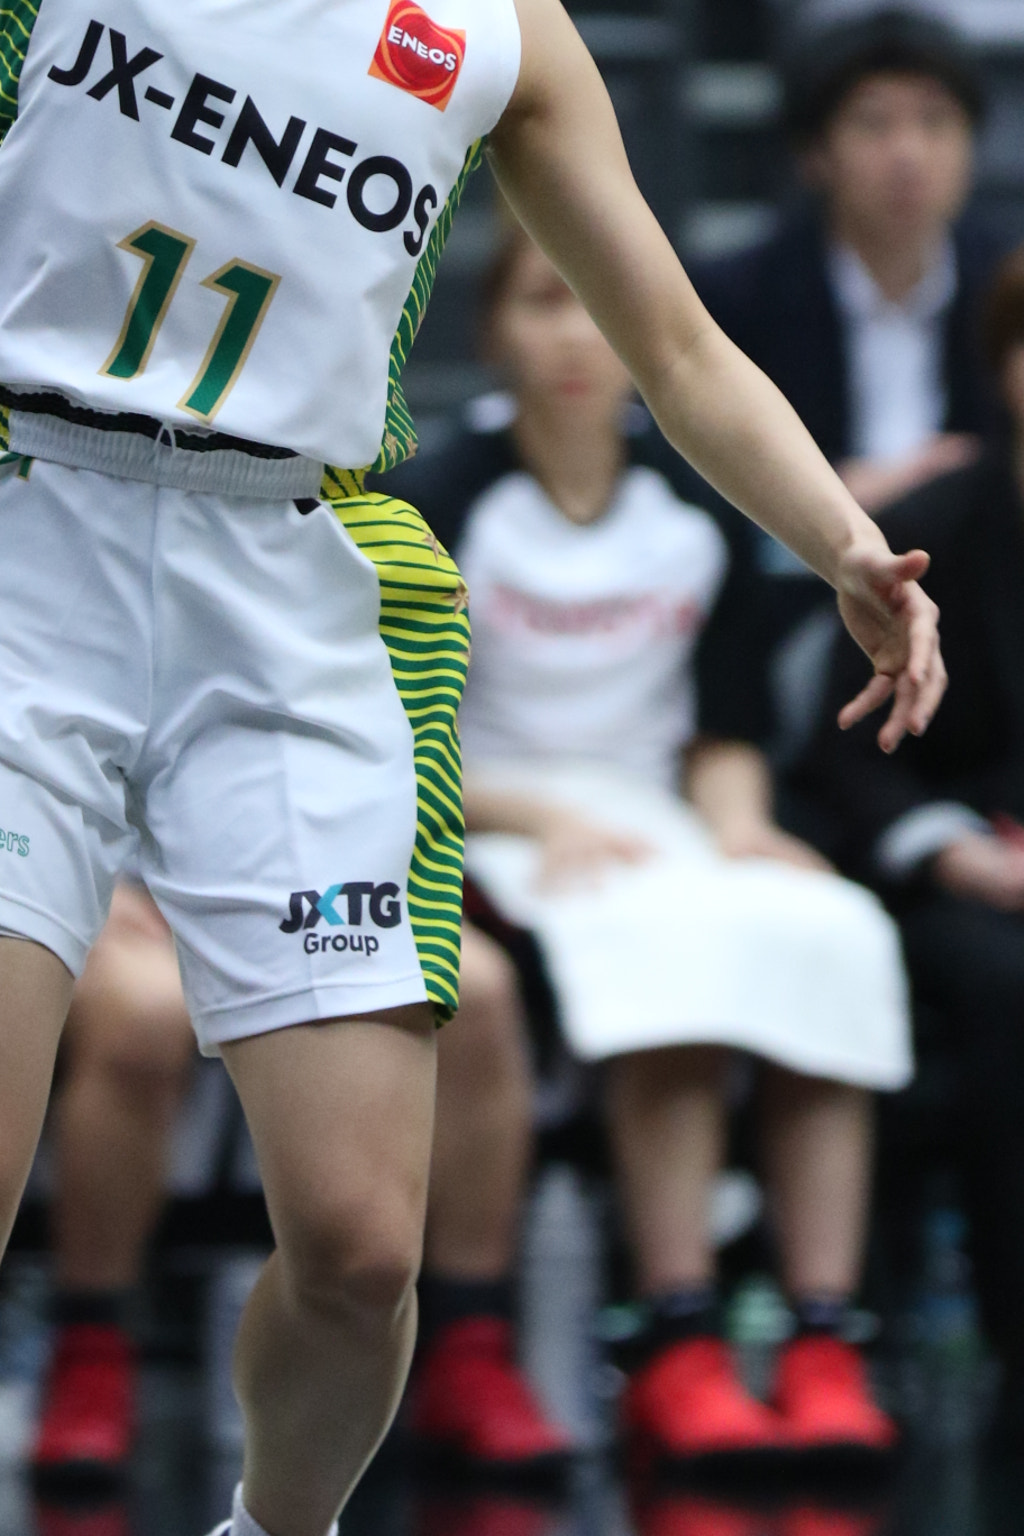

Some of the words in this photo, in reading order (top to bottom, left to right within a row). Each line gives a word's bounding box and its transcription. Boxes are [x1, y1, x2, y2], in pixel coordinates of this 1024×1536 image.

[387, 24, 457, 72] ENEOS
[47, 19, 437, 257] JX-ENEOS
[96, 219, 282, 424] 11
[279, 881, 402, 934] JXTG
[303, 932, 380, 957] Group
